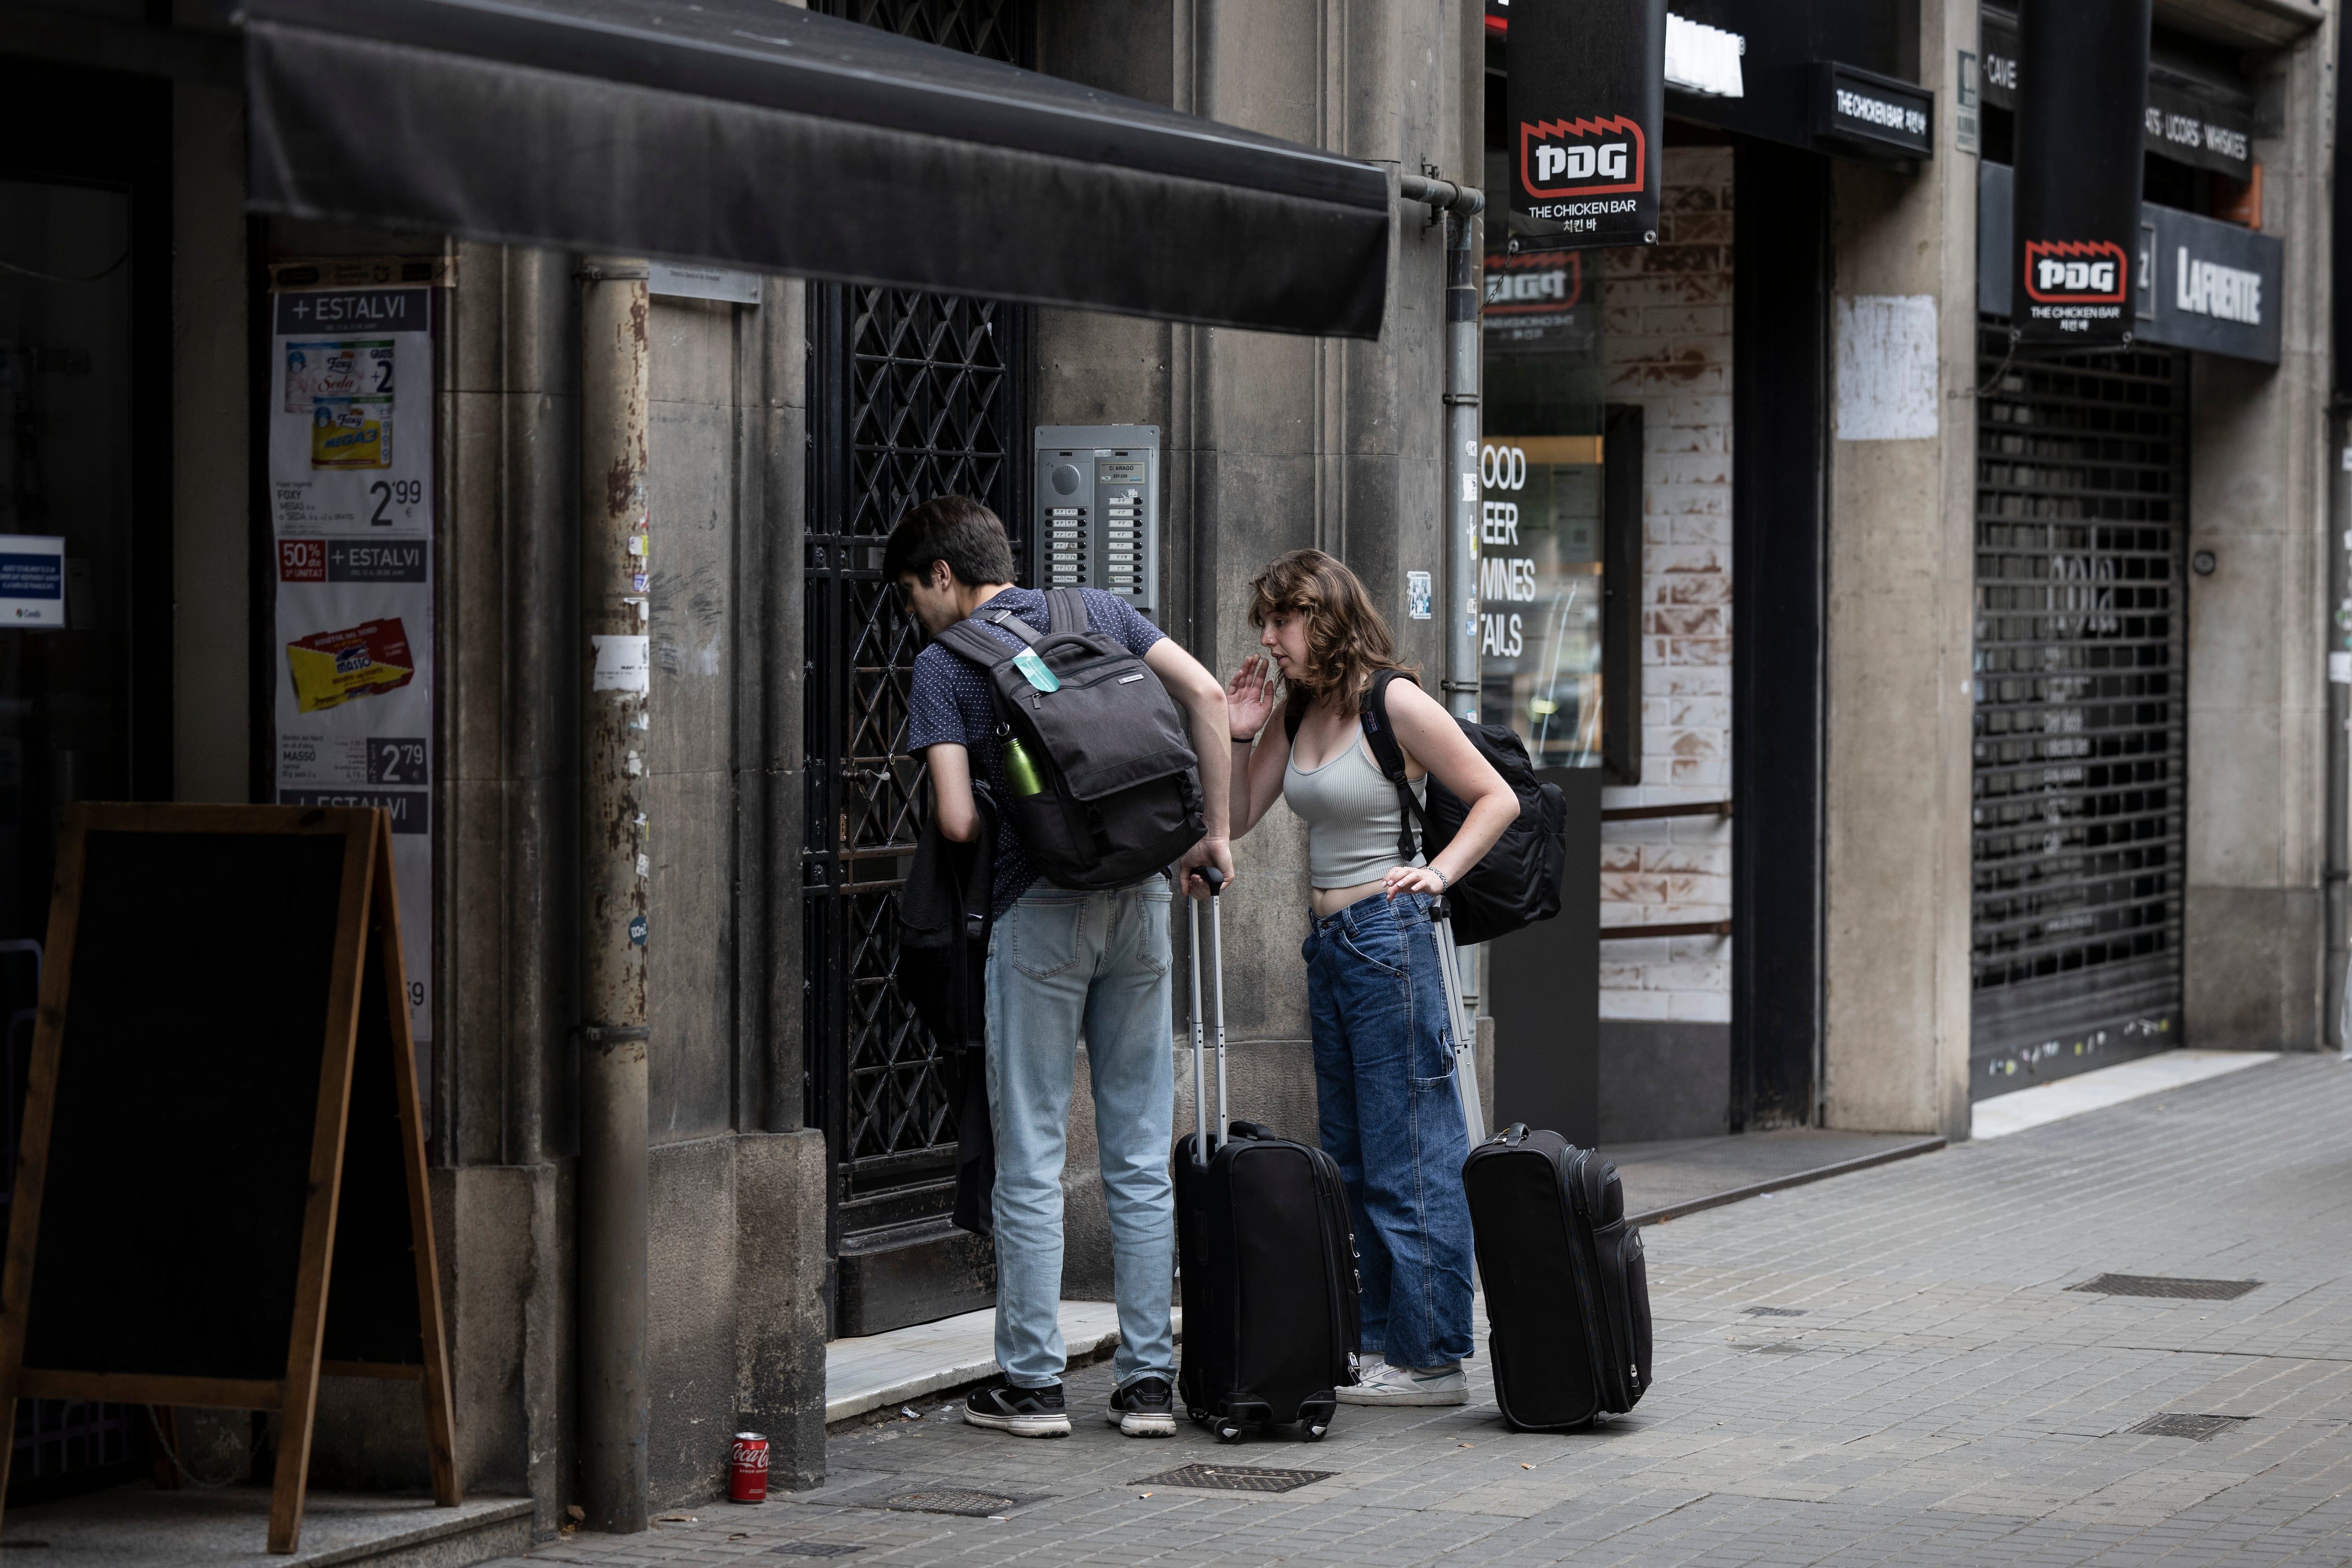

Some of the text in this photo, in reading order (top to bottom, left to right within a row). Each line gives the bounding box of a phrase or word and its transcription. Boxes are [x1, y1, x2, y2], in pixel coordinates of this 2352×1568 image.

[1836, 89, 1905, 130] THE CHICKEN BAR
[2165, 112, 2200, 148] LICORS
[2204, 123, 2248, 161] WHISKIES
[1536, 143, 1627, 181] PDG
[1529, 200, 1636, 218] THE CHICKEN BAR
[1564, 218, 1597, 232] 치킨 바
[2038, 258, 2115, 292] PDG
[2177, 246, 2262, 326] LAFUENTE
[316, 295, 405, 320] ESTALVI
[2030, 306, 2121, 318] THE CHICKEN BAR
[327, 358, 352, 371] Foxy
[338, 414, 363, 426] Foxy
[1481, 444, 1526, 491] OOD
[278, 490, 302, 500] FOXY
[1481, 501, 1519, 546] EER
[349, 548, 419, 565] ESTALVI
[295, 569, 323, 578] UNITAT
